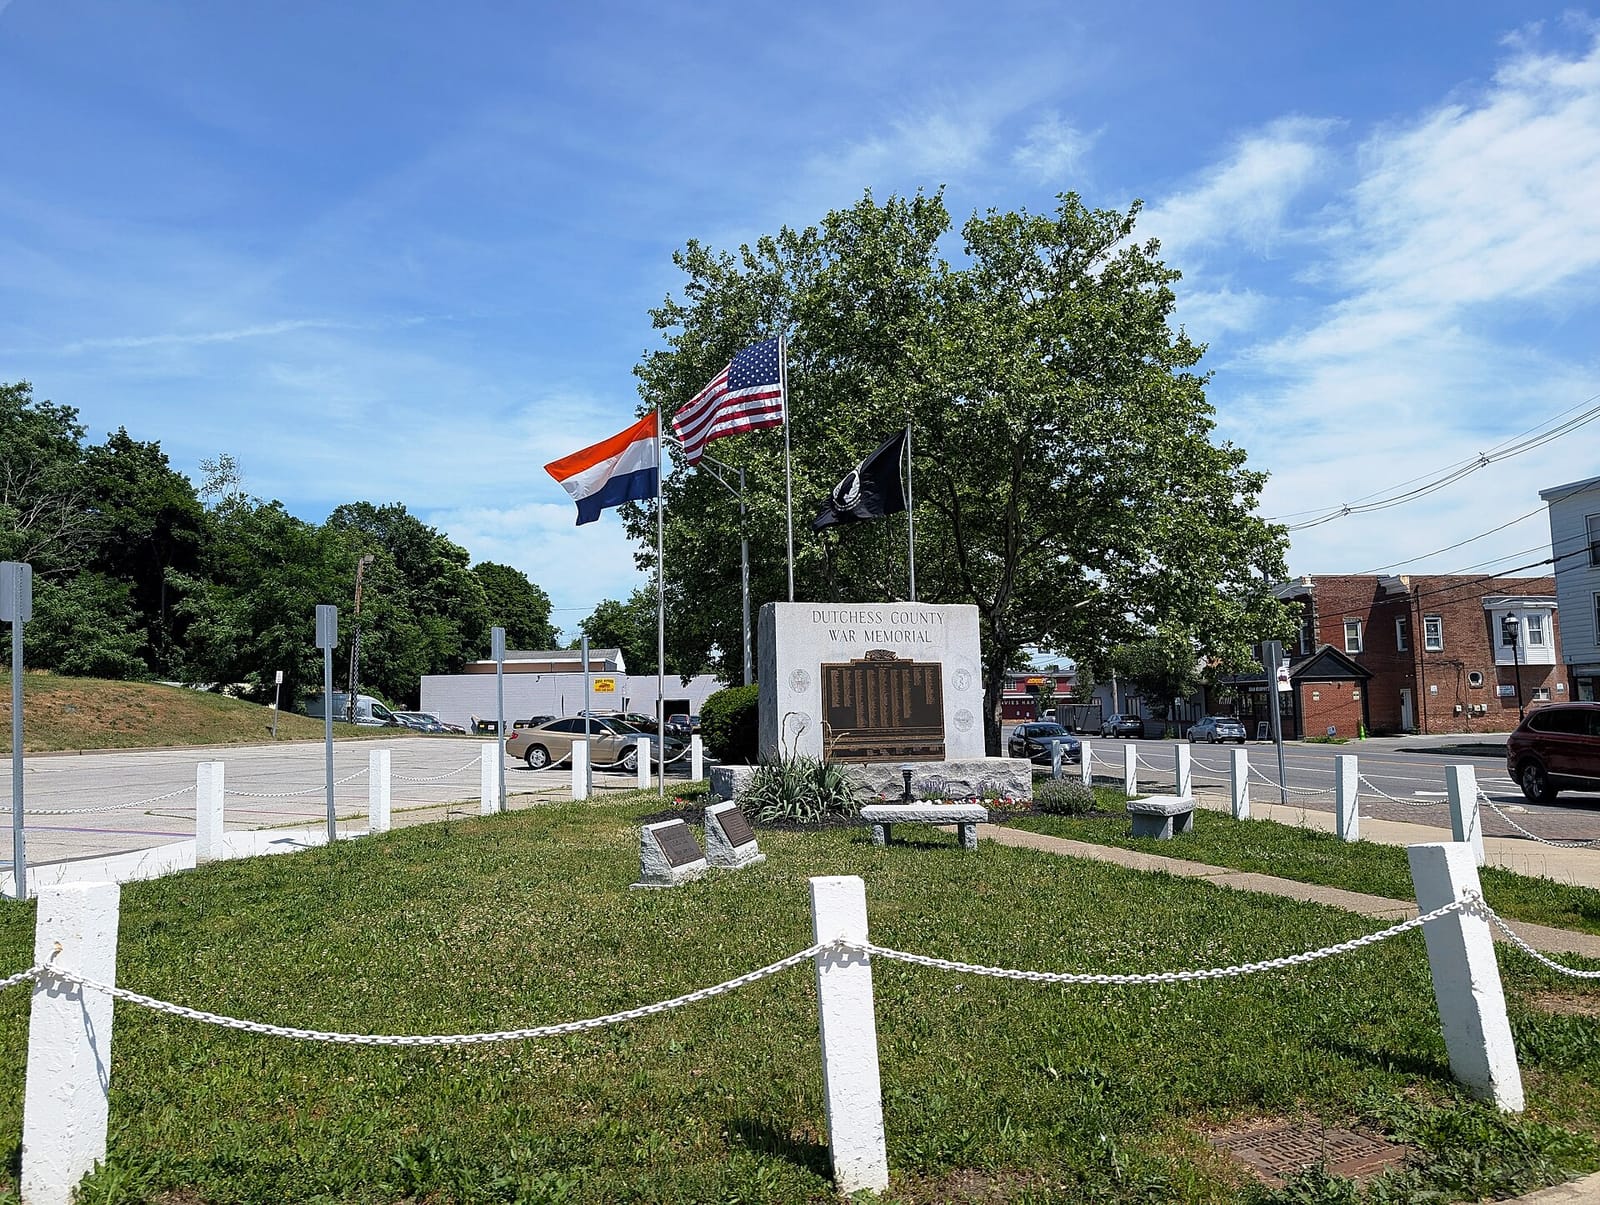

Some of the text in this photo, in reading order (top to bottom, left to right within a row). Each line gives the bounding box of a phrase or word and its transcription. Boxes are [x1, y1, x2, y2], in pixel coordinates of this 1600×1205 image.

[812, 610, 945, 625] DUTCHESS COUNTY
[829, 629, 932, 643] WAR MEMORIAL
